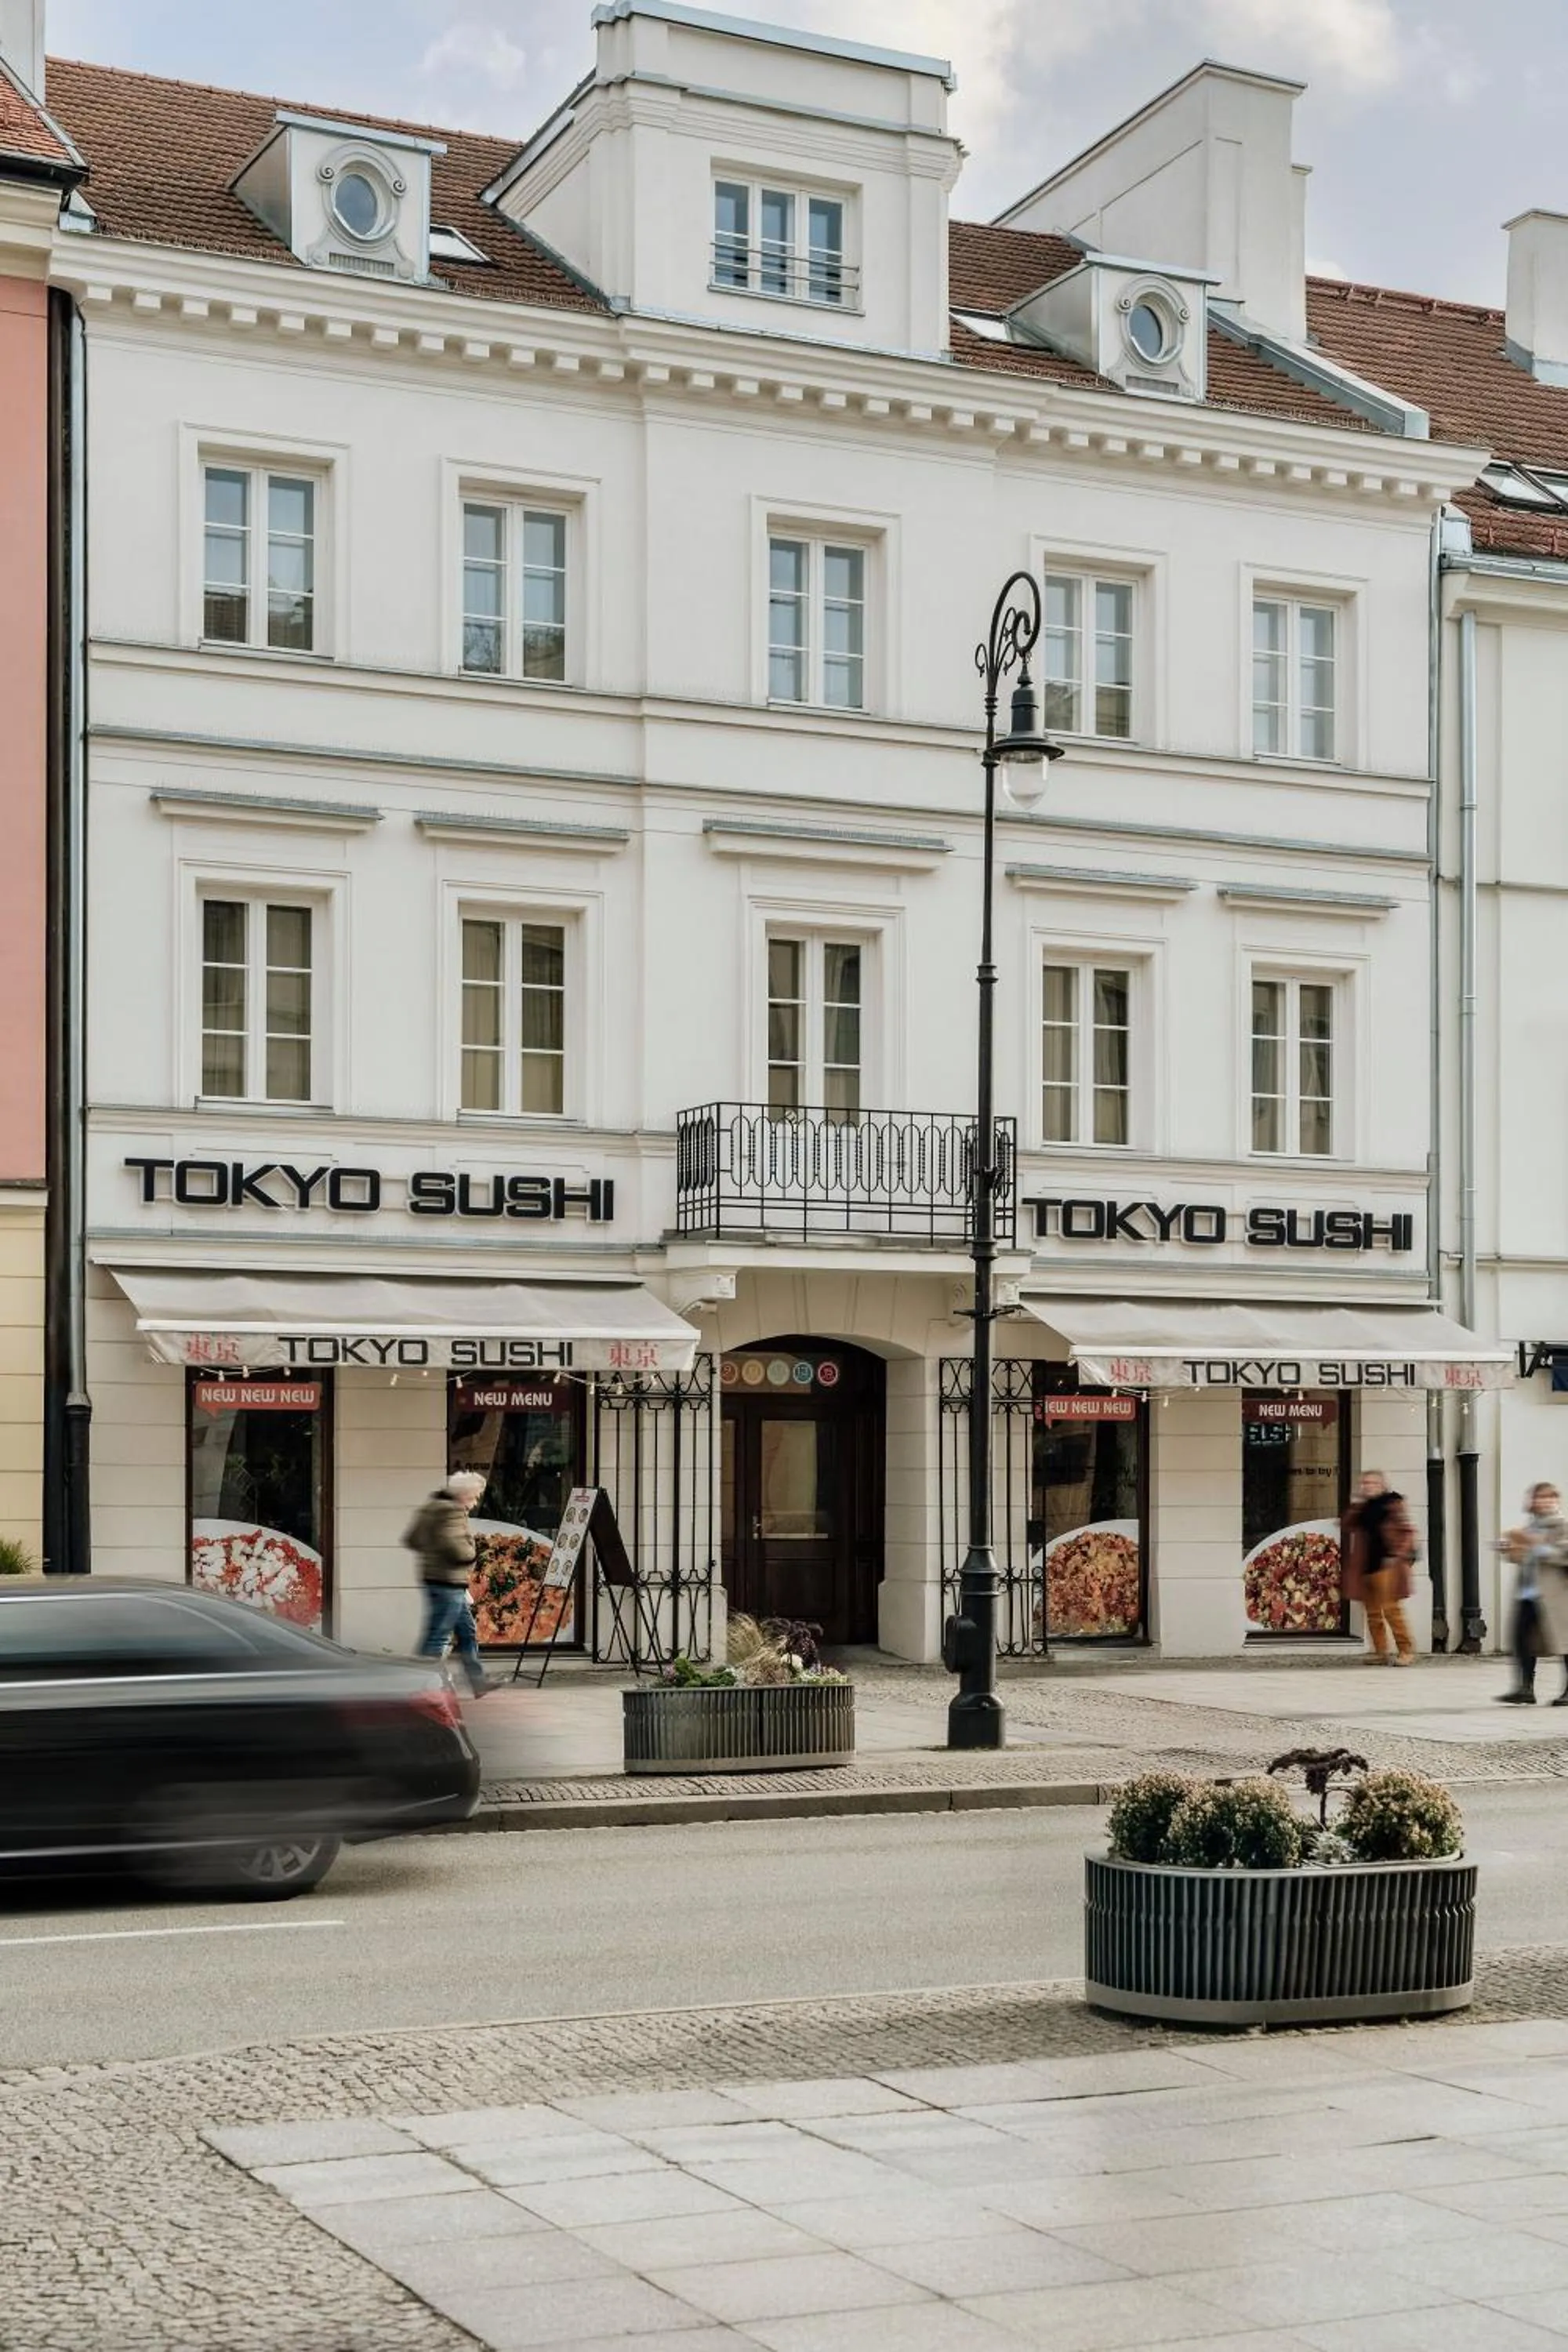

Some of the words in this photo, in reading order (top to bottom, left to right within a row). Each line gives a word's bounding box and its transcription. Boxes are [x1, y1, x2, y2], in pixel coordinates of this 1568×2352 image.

[125, 1158, 381, 1211] TOKYO
[408, 1172, 614, 1221] SUSHI
[1022, 1197, 1226, 1244] TOKYO
[1247, 1208, 1412, 1250] SUSHI
[278, 1336, 429, 1365] TOKYO
[451, 1340, 573, 1367] SUSHI
[609, 1341, 659, 1367] 東京
[1109, 1357, 1151, 1383] 東京
[1182, 1360, 1301, 1385] TOKYO
[1318, 1363, 1415, 1386] SUSHI
[201, 1388, 235, 1402] NEW
[241, 1388, 275, 1403] NEW
[281, 1390, 314, 1403] NEW
[474, 1392, 507, 1406] NEW
[511, 1392, 553, 1406] MENU
[1072, 1402, 1099, 1414] NEW
[1103, 1402, 1131, 1415] NEW
[1259, 1404, 1285, 1417] NEW
[1288, 1404, 1323, 1417] MENU
